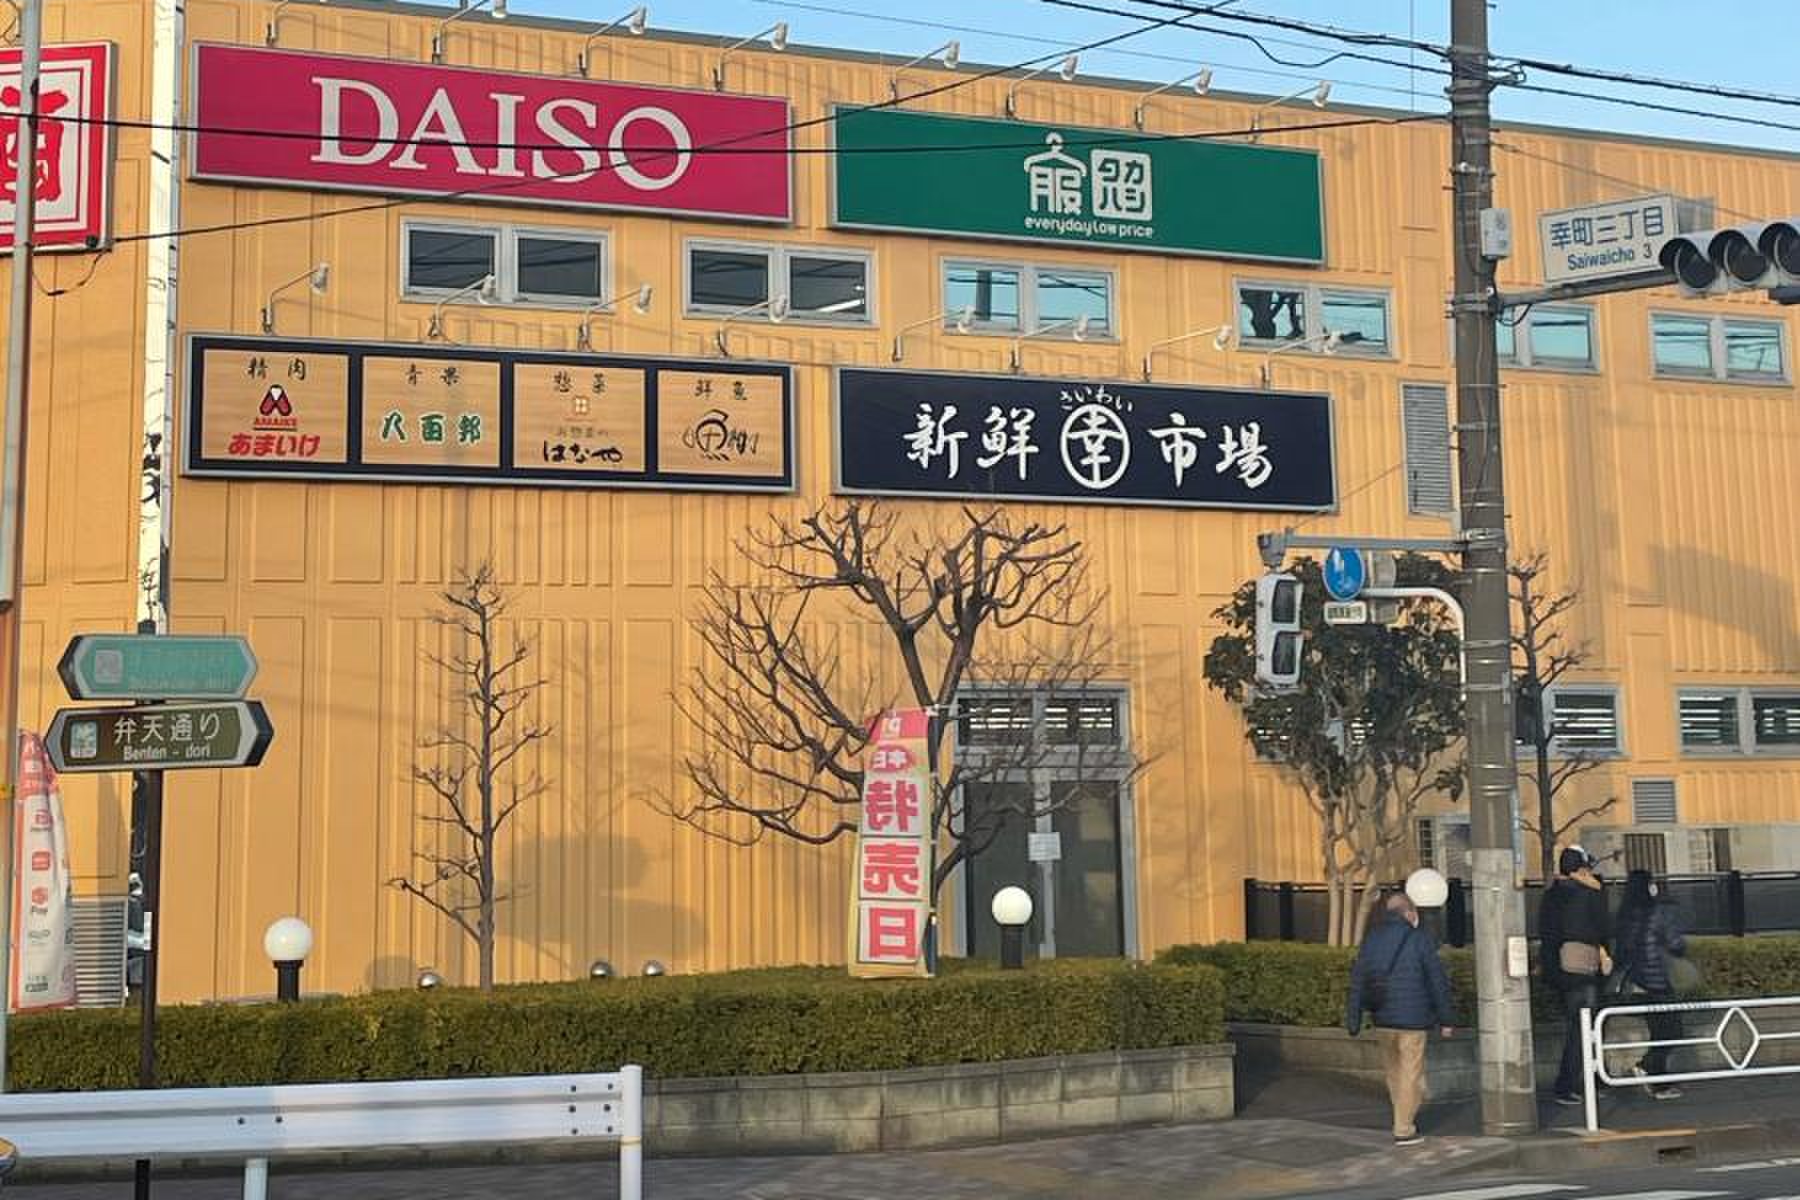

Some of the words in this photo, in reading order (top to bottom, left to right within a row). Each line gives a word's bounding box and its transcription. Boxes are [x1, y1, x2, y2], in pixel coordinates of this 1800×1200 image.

[310, 77, 693, 191] DAISO
[1024, 217, 1093, 236] everyday
[1119, 224, 1153, 238] price
[1550, 206, 1664, 249] 幸町三丁目
[1567, 247, 1635, 271] Saiwaicho
[1642, 242, 1653, 259] 3
[247, 357, 308, 381] 精肉
[1059, 386, 1134, 413] さいわい
[228, 432, 321, 458] あまいけ
[543, 440, 623, 464] はなや
[113, 711, 221, 744] 弁天通り
[123, 745, 168, 761] Benten
